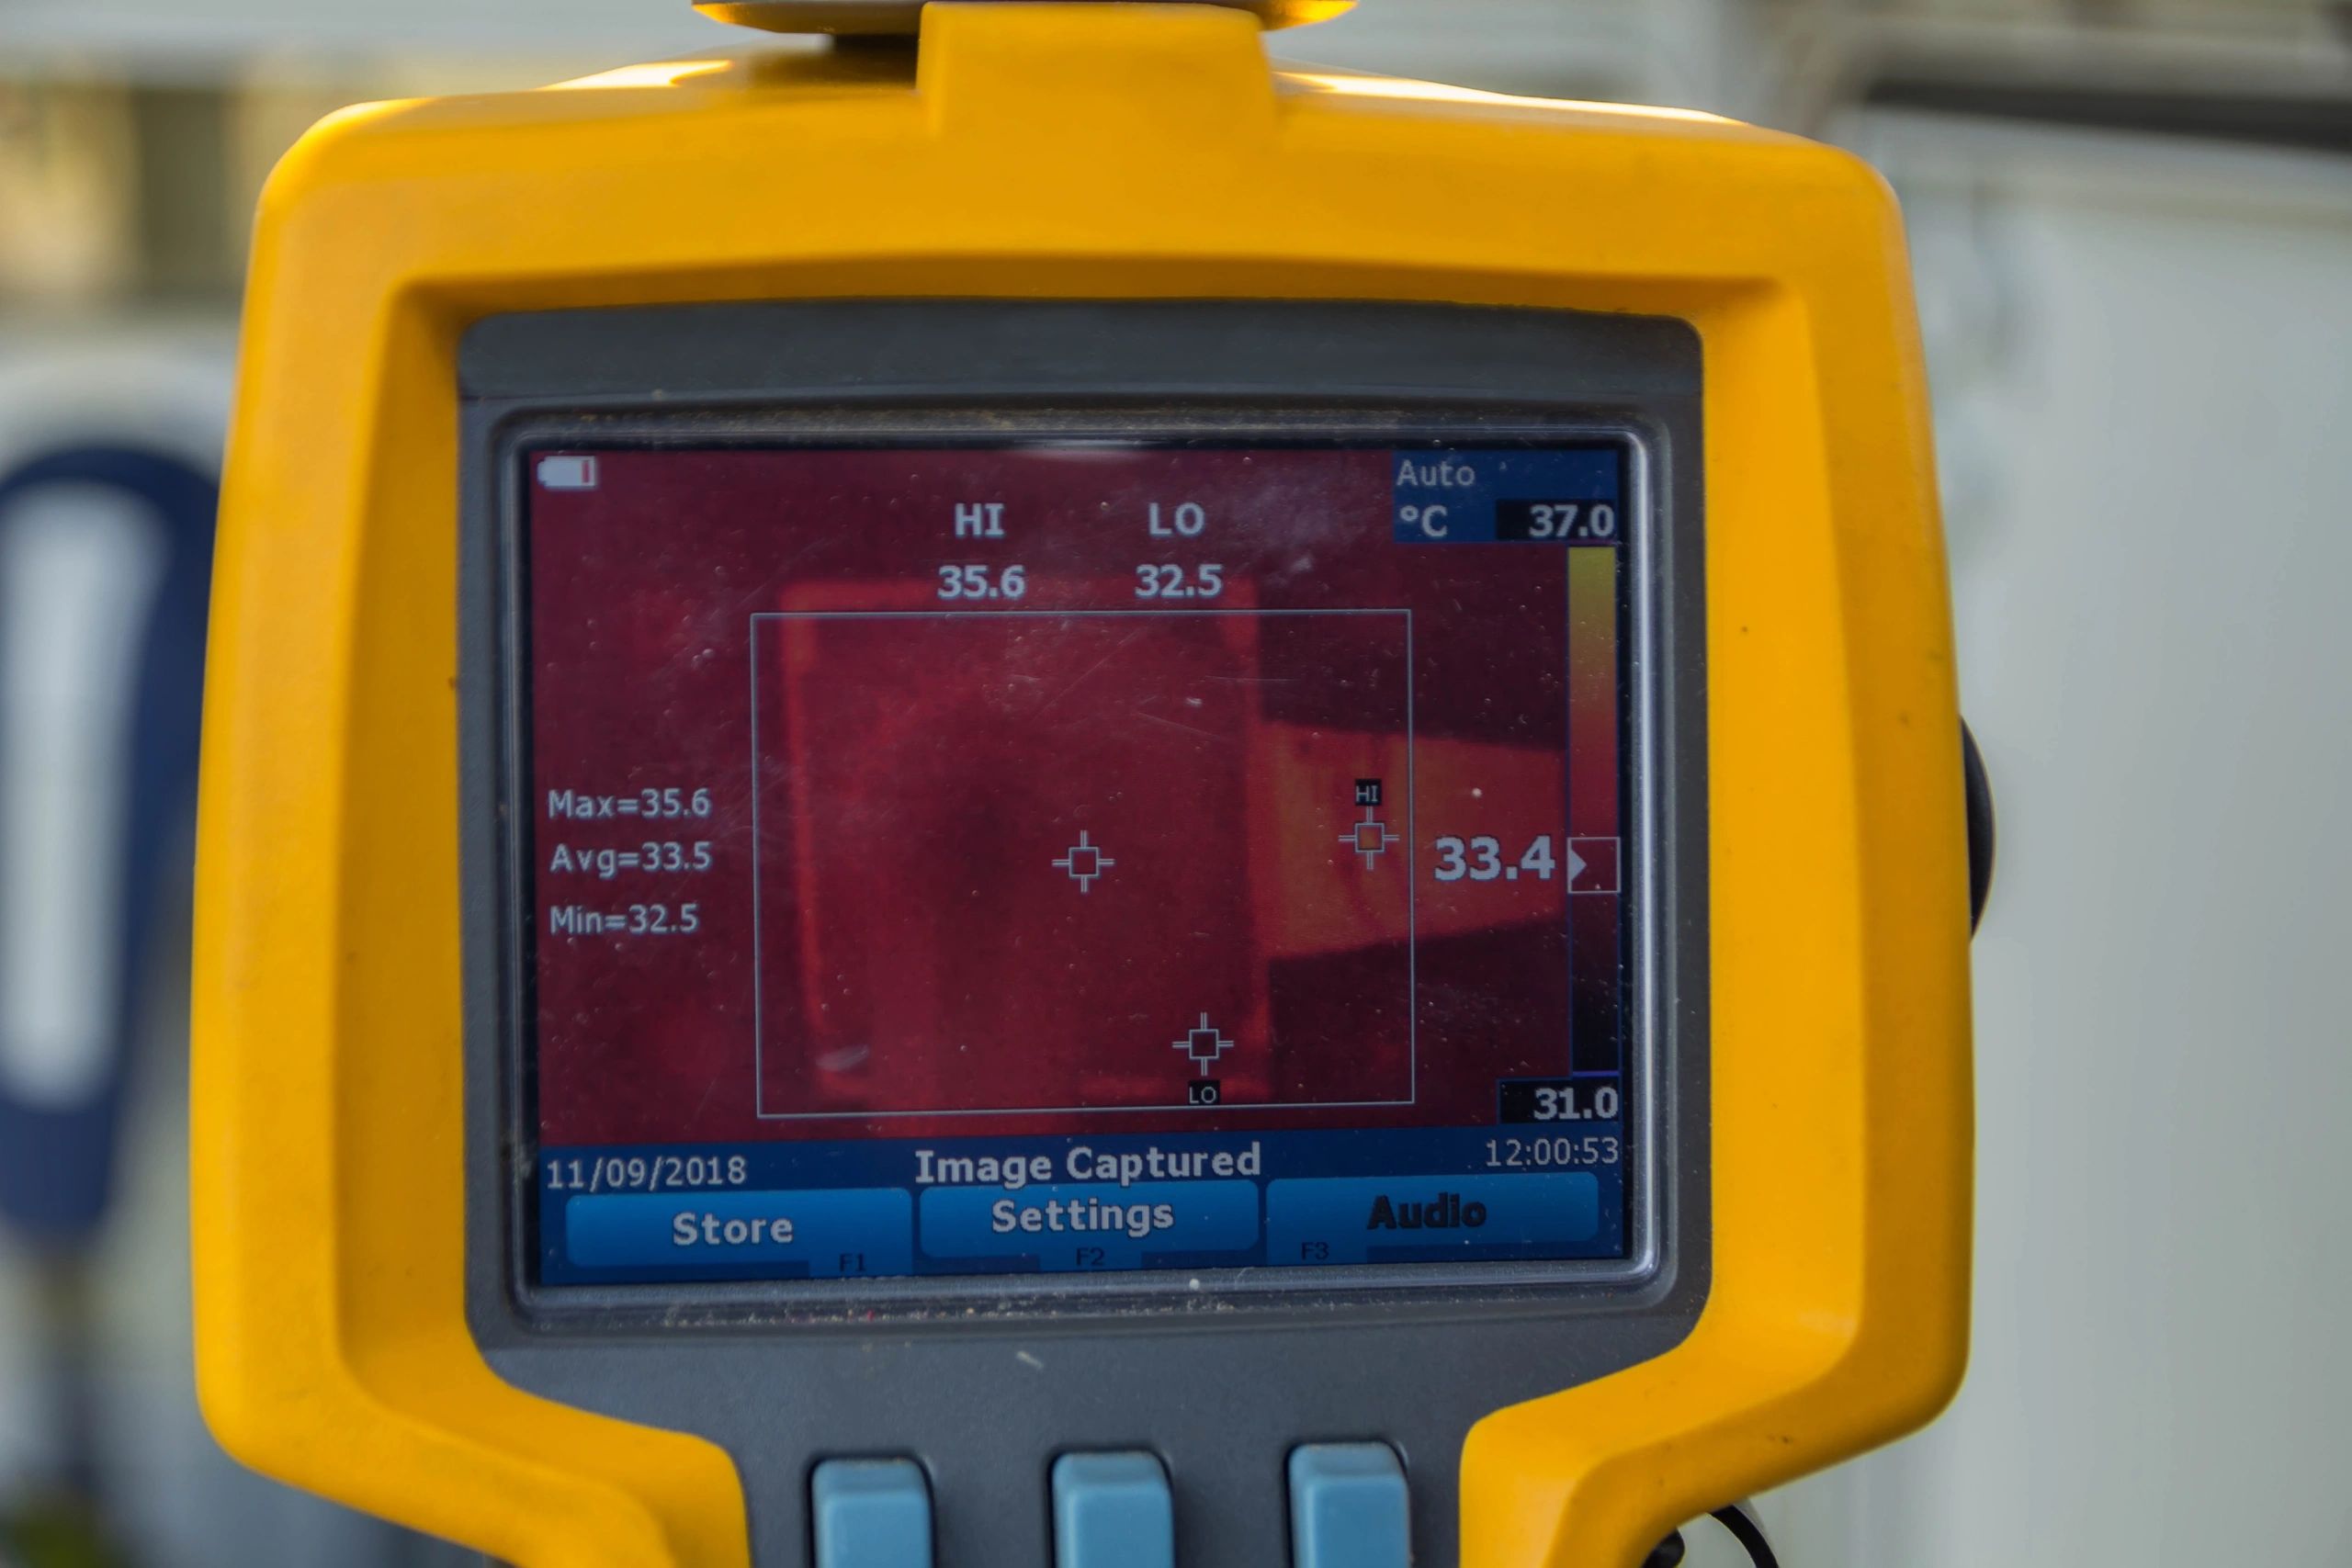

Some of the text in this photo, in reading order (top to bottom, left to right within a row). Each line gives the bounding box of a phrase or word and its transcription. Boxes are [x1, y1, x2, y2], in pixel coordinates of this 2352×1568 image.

[1396, 458, 1476, 487] Auto
[954, 502, 1006, 537] HI
[1148, 502, 1206, 536] LO
[1528, 503, 1615, 538] 37.0
[936, 564, 1027, 599] 35.6
[1134, 563, 1224, 598] 32.5
[548, 787, 711, 819] Max=35.6
[1355, 784, 1379, 804] HI
[549, 840, 712, 879] Avg=33.5
[1434, 835, 1555, 881] 33.4
[549, 903, 700, 936] Min=32.5
[1189, 1086, 1217, 1104] LO
[1532, 1086, 1621, 1121] 31.0
[914, 1141, 1261, 1190] Image Captured
[1485, 1136, 1620, 1168] 12:00:53
[547, 1155, 748, 1192] 11/09/2018
[991, 1197, 1174, 1238] Settings
[1366, 1191, 1487, 1230] Audio
[672, 1211, 794, 1247] Store
[837, 1252, 867, 1273] F1
[1075, 1247, 1106, 1268] F2
[1300, 1240, 1330, 1261] F3
